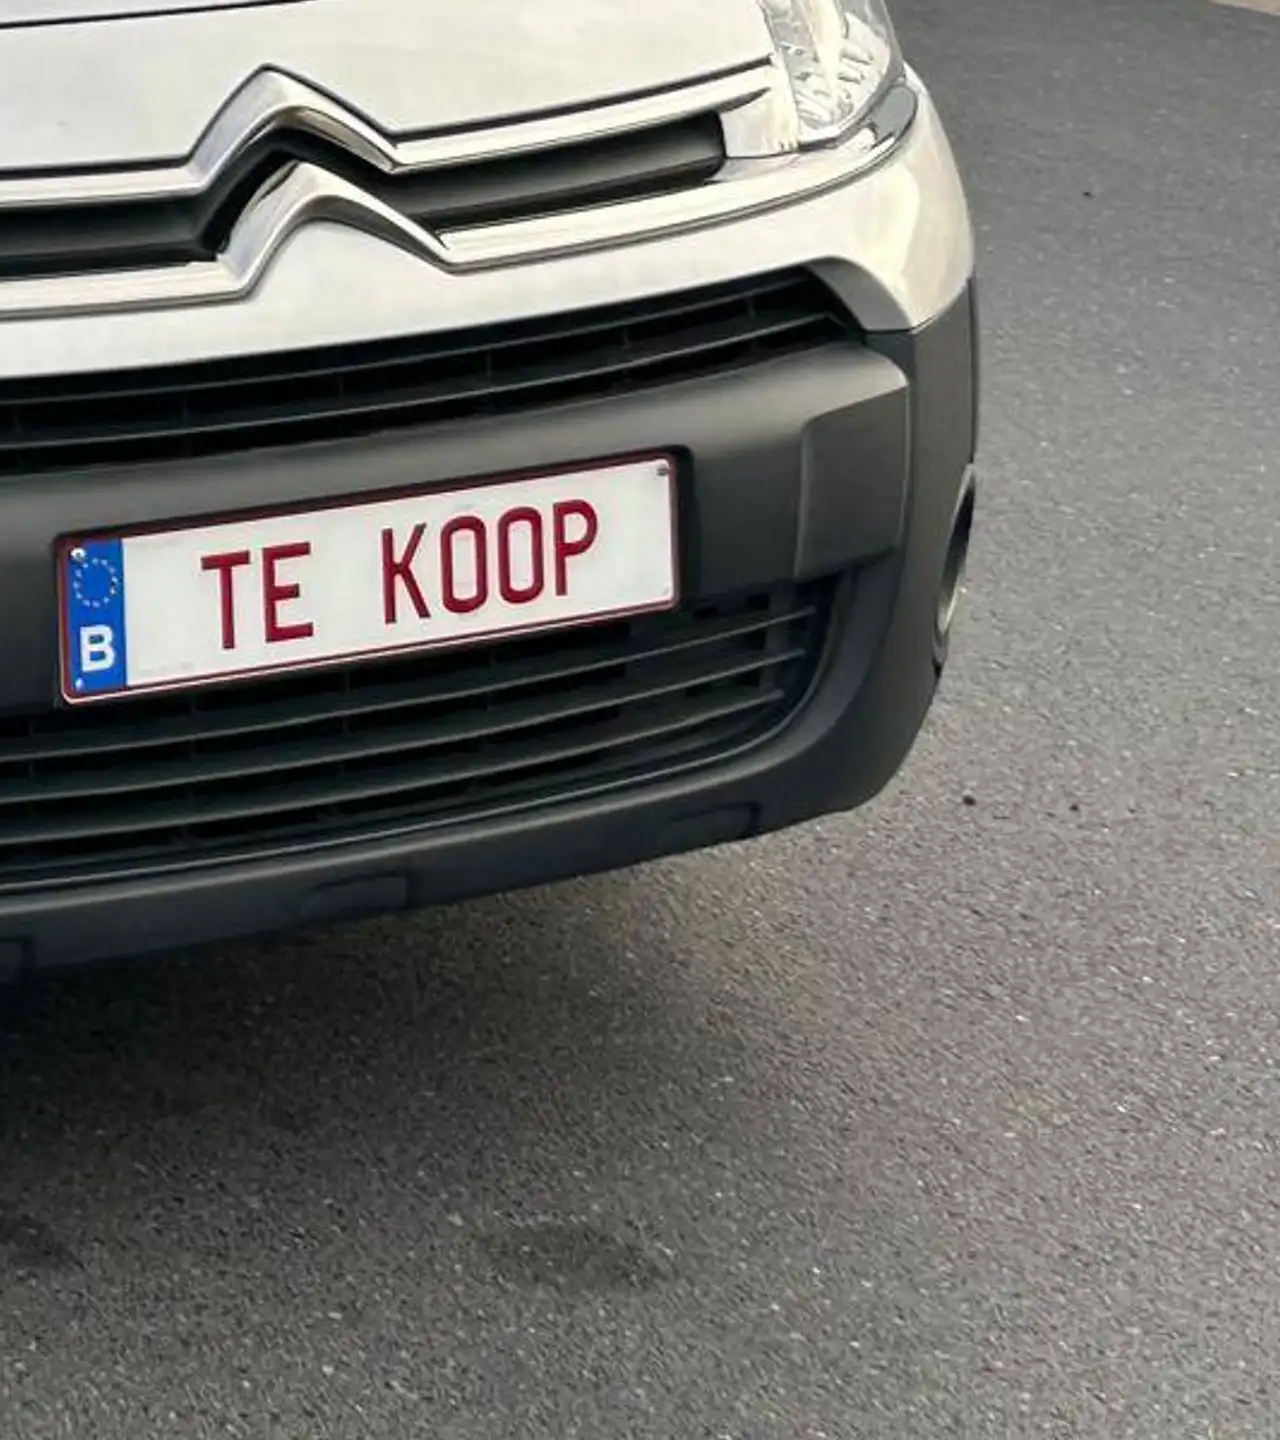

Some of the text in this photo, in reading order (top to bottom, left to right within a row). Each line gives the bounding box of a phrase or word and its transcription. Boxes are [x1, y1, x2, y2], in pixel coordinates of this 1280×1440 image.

[201, 498, 598, 649] TE KOOP
[80, 625, 115, 672] B
